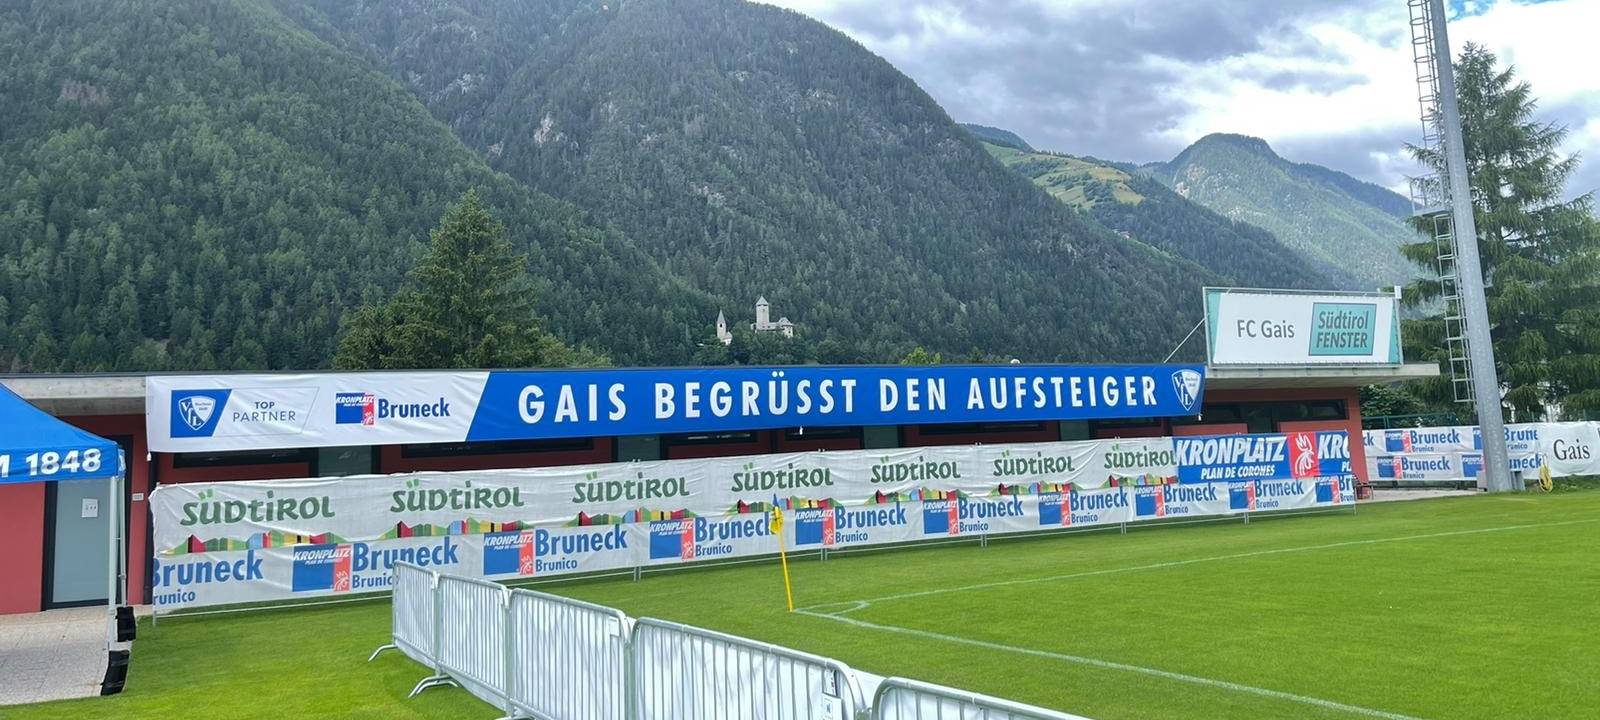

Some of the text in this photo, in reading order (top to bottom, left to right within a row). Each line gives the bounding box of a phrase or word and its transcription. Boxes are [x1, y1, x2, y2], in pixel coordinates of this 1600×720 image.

[1236, 319, 1295, 339] FC Gais
[1318, 309, 1369, 331] Südtirol
[1316, 331, 1368, 349] FENSTER
[254, 401, 275, 410] TOP
[335, 395, 451, 419] KRONPLATZ Bruneck
[518, 370, 1157, 424] GAIS BEGRÜSST DEN AUFSTEIGER
[232, 410, 296, 423] PARTNER
[1410, 428, 1461, 445] Bruneck
[1175, 436, 1288, 467] KRONPLATZ
[1553, 438, 1591, 461] Gais
[25, 448, 101, 476] 1848
[1201, 464, 1275, 480] PLAN DE CORONES
[1401, 456, 1450, 471] Bruneck
[1164, 483, 1216, 503] Bruneck
[1255, 479, 1304, 497] Bruneck
[959, 494, 1024, 519] Bruneck
[1070, 486, 1128, 511] Bruneck
[836, 501, 907, 530] Bruneck
[1072, 513, 1098, 523] Brunico
[836, 531, 868, 543] Brunico
[960, 522, 988, 532] Brunico
[484, 524, 627, 557] KRONPLATZ Bruneck
[696, 543, 732, 557] Brunico
[293, 536, 459, 571] KRONPLATZ Bruneck
[536, 558, 577, 572] Brunico
